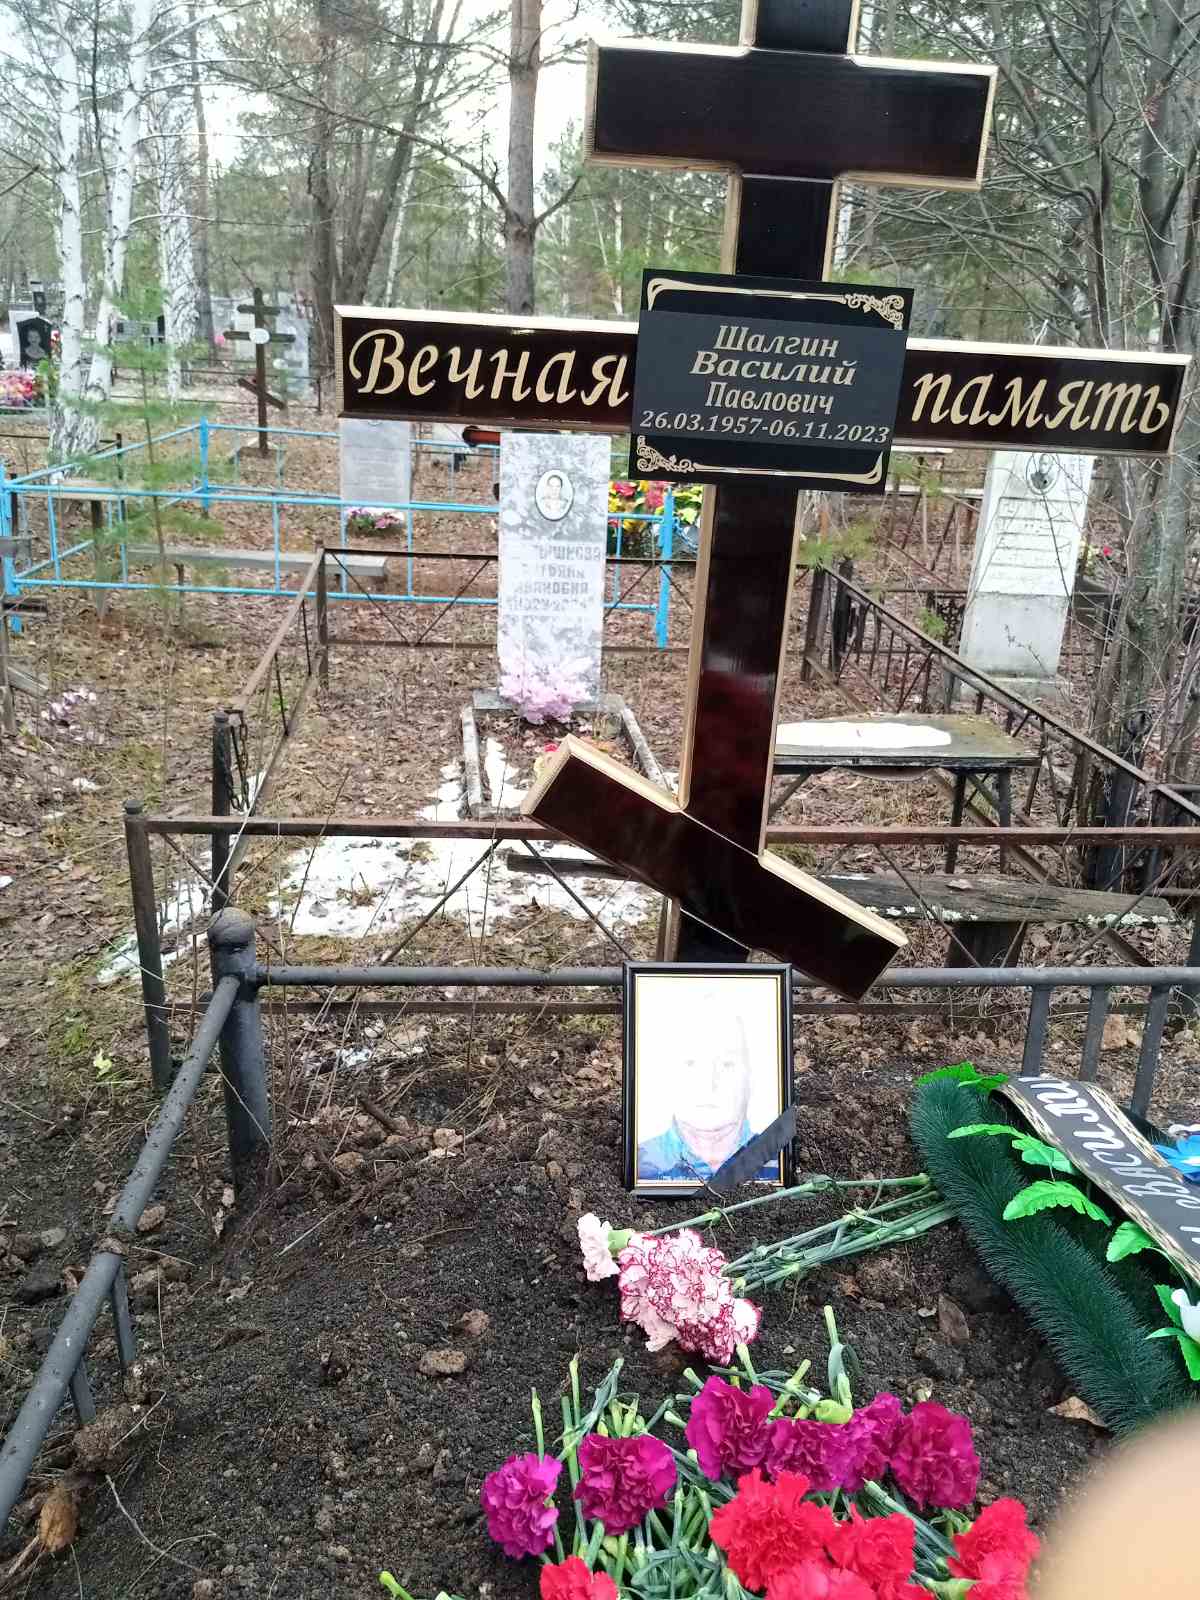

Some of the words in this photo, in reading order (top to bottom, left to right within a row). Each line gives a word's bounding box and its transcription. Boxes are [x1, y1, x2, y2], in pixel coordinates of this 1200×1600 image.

[713, 324, 839, 358] Шалгин
[349, 328, 629, 407] Вечная
[911, 372, 1170, 434] память
[689, 350, 857, 386] Василий
[704, 381, 834, 415] Павлович
[640, 410, 891, 444] 26.03.1957-06.11.2023
